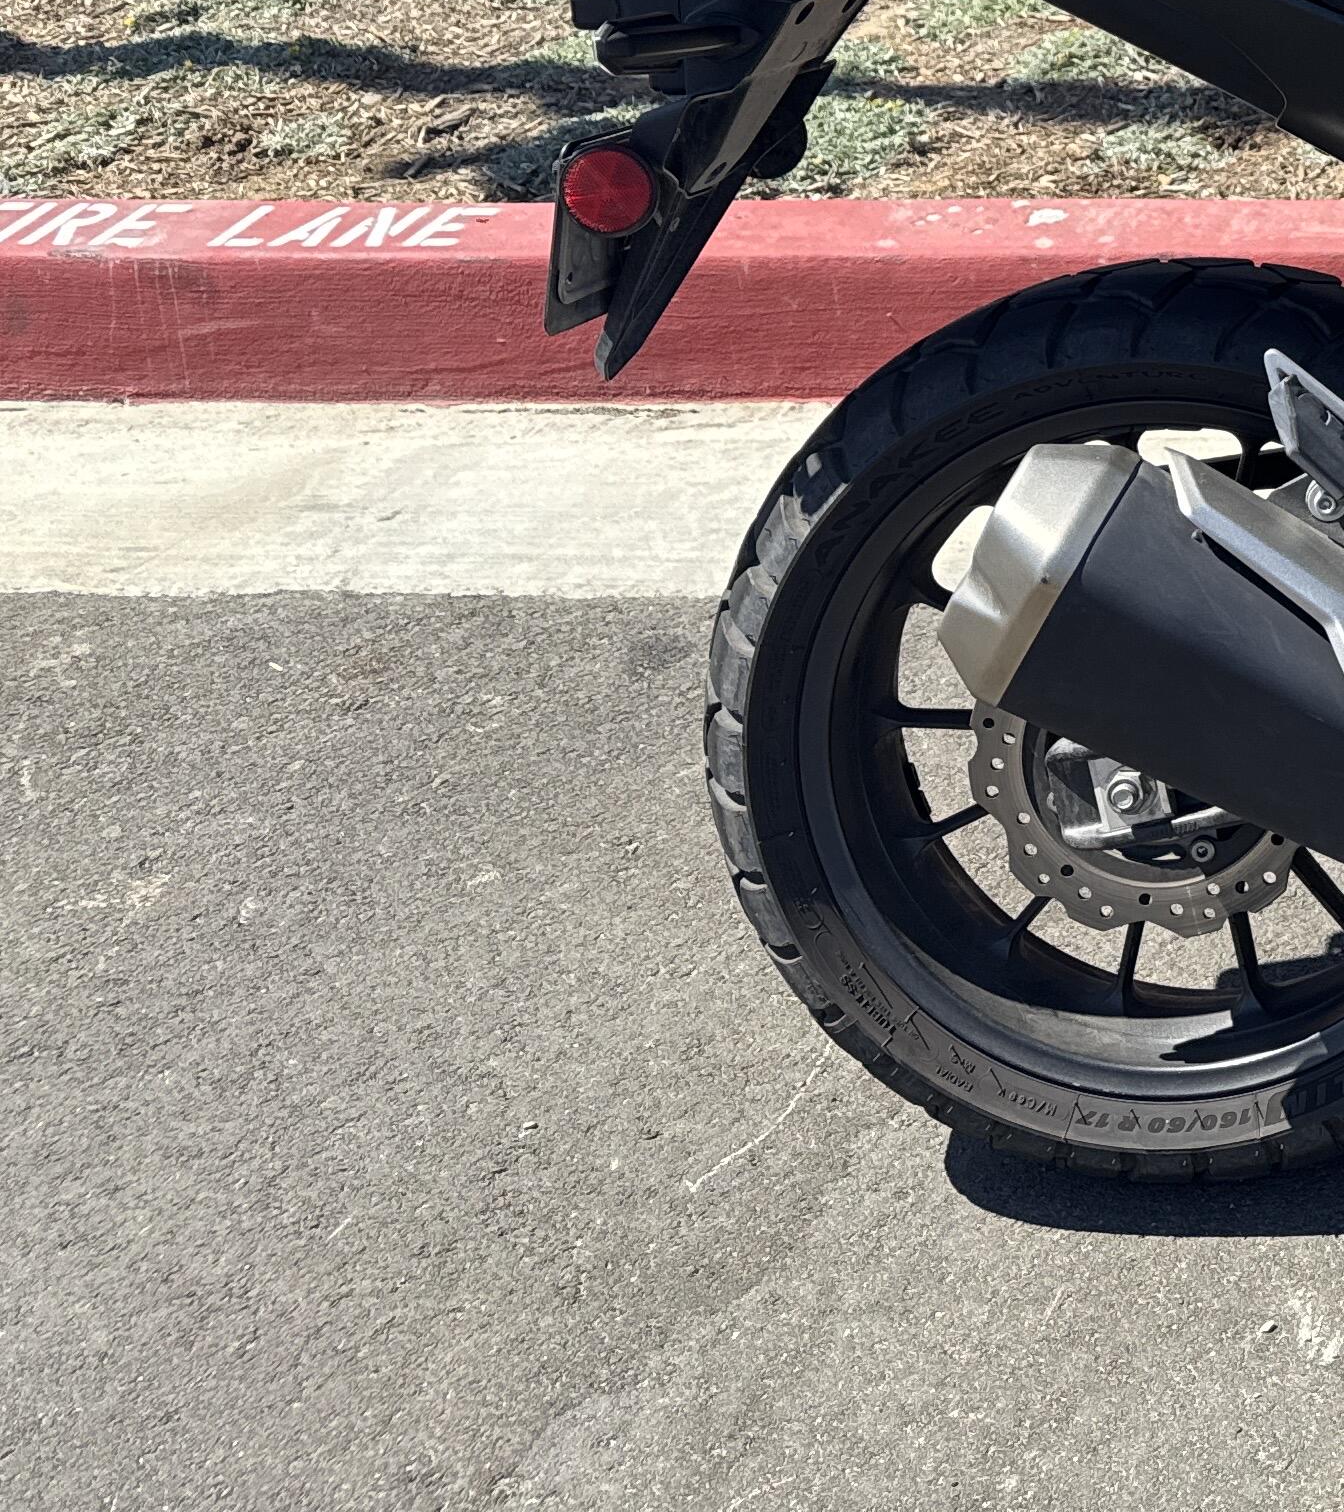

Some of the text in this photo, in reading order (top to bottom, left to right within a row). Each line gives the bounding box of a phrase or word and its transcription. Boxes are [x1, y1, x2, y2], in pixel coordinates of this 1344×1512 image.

[0, 201, 500, 248] IRE LANE
[1013, 370, 1208, 402] ADVENTURE
[813, 399, 1005, 571] ANAKEE
[935, 1066, 975, 1094] RADIAL
[1075, 1110, 1110, 1129] 17
[1117, 1114, 1139, 1133] R
[1147, 1107, 1251, 1135] 160/60
